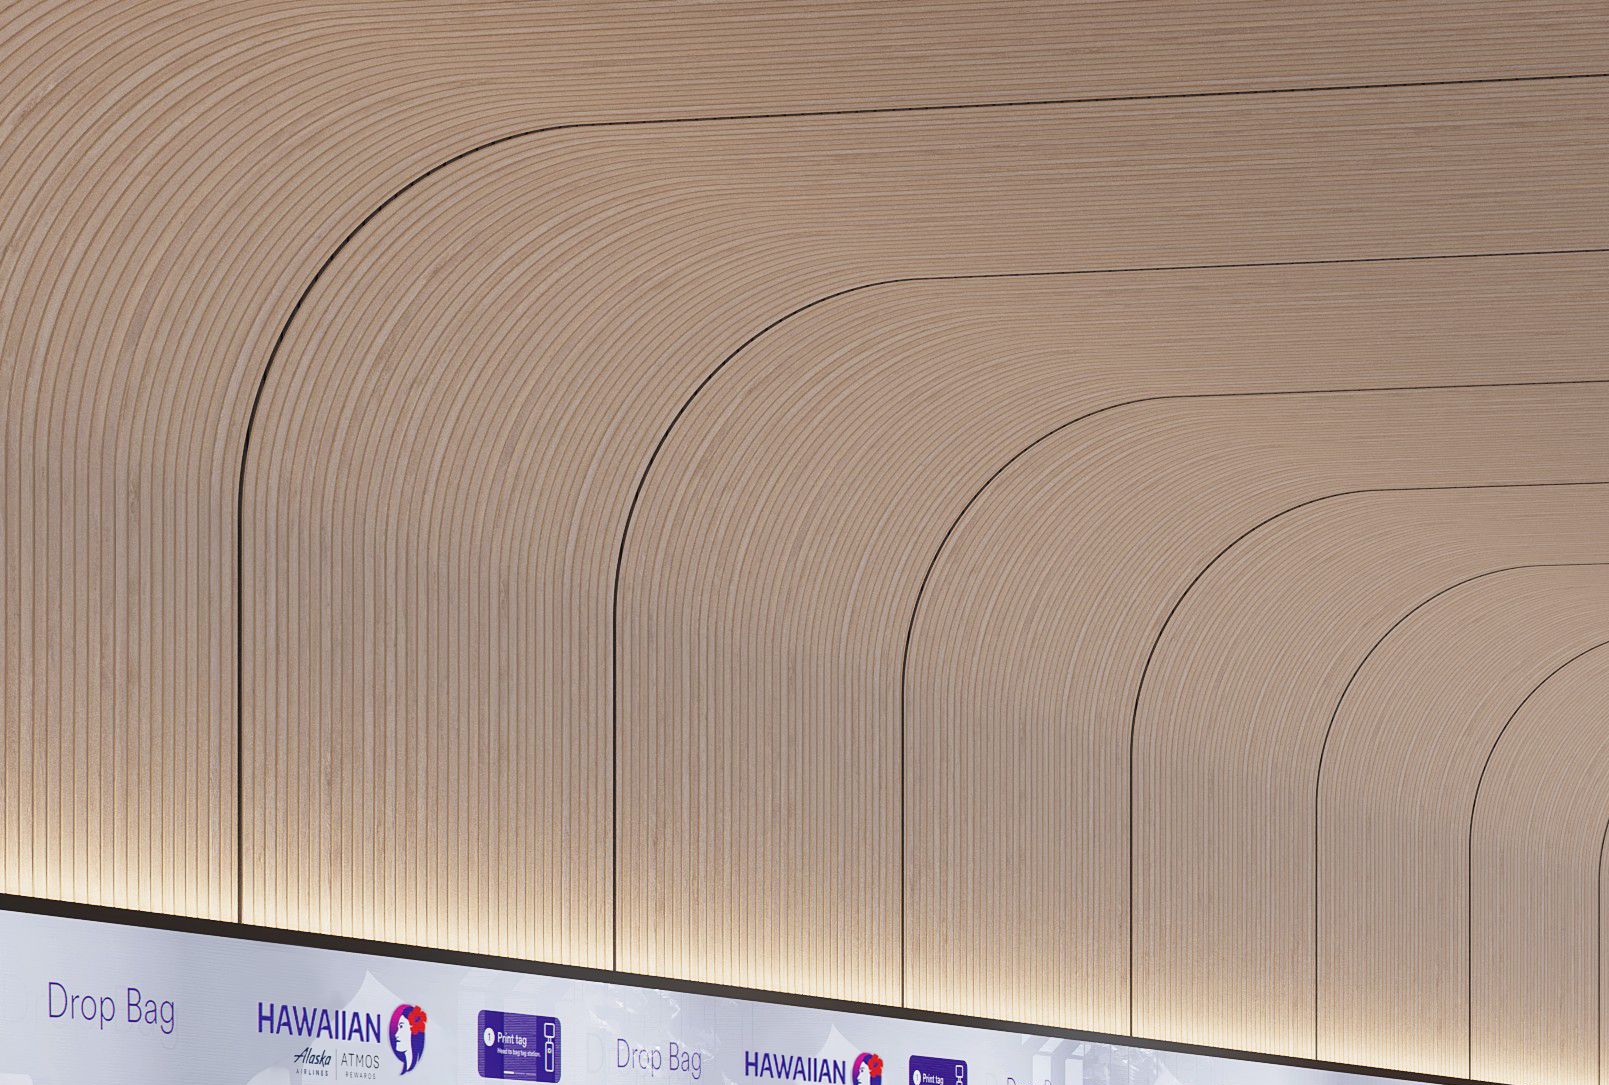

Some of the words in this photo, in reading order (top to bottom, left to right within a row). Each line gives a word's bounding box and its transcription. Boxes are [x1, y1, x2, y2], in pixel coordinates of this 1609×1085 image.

[49, 982, 115, 1030] Drop
[127, 987, 174, 1034] Bag
[258, 1002, 381, 1043] HAWAIIAN
[497, 1032, 514, 1044] Print
[515, 1035, 527, 1048] tag
[294, 1047, 331, 1067] Alaska
[340, 1052, 380, 1069] ATMOS
[617, 1038, 661, 1077] Drop
[669, 1042, 702, 1079] Bag
[296, 1068, 329, 1077] AIRLINES
[745, 1051, 846, 1085] HAWAIIAN
[922, 1073, 935, 1084] Print
